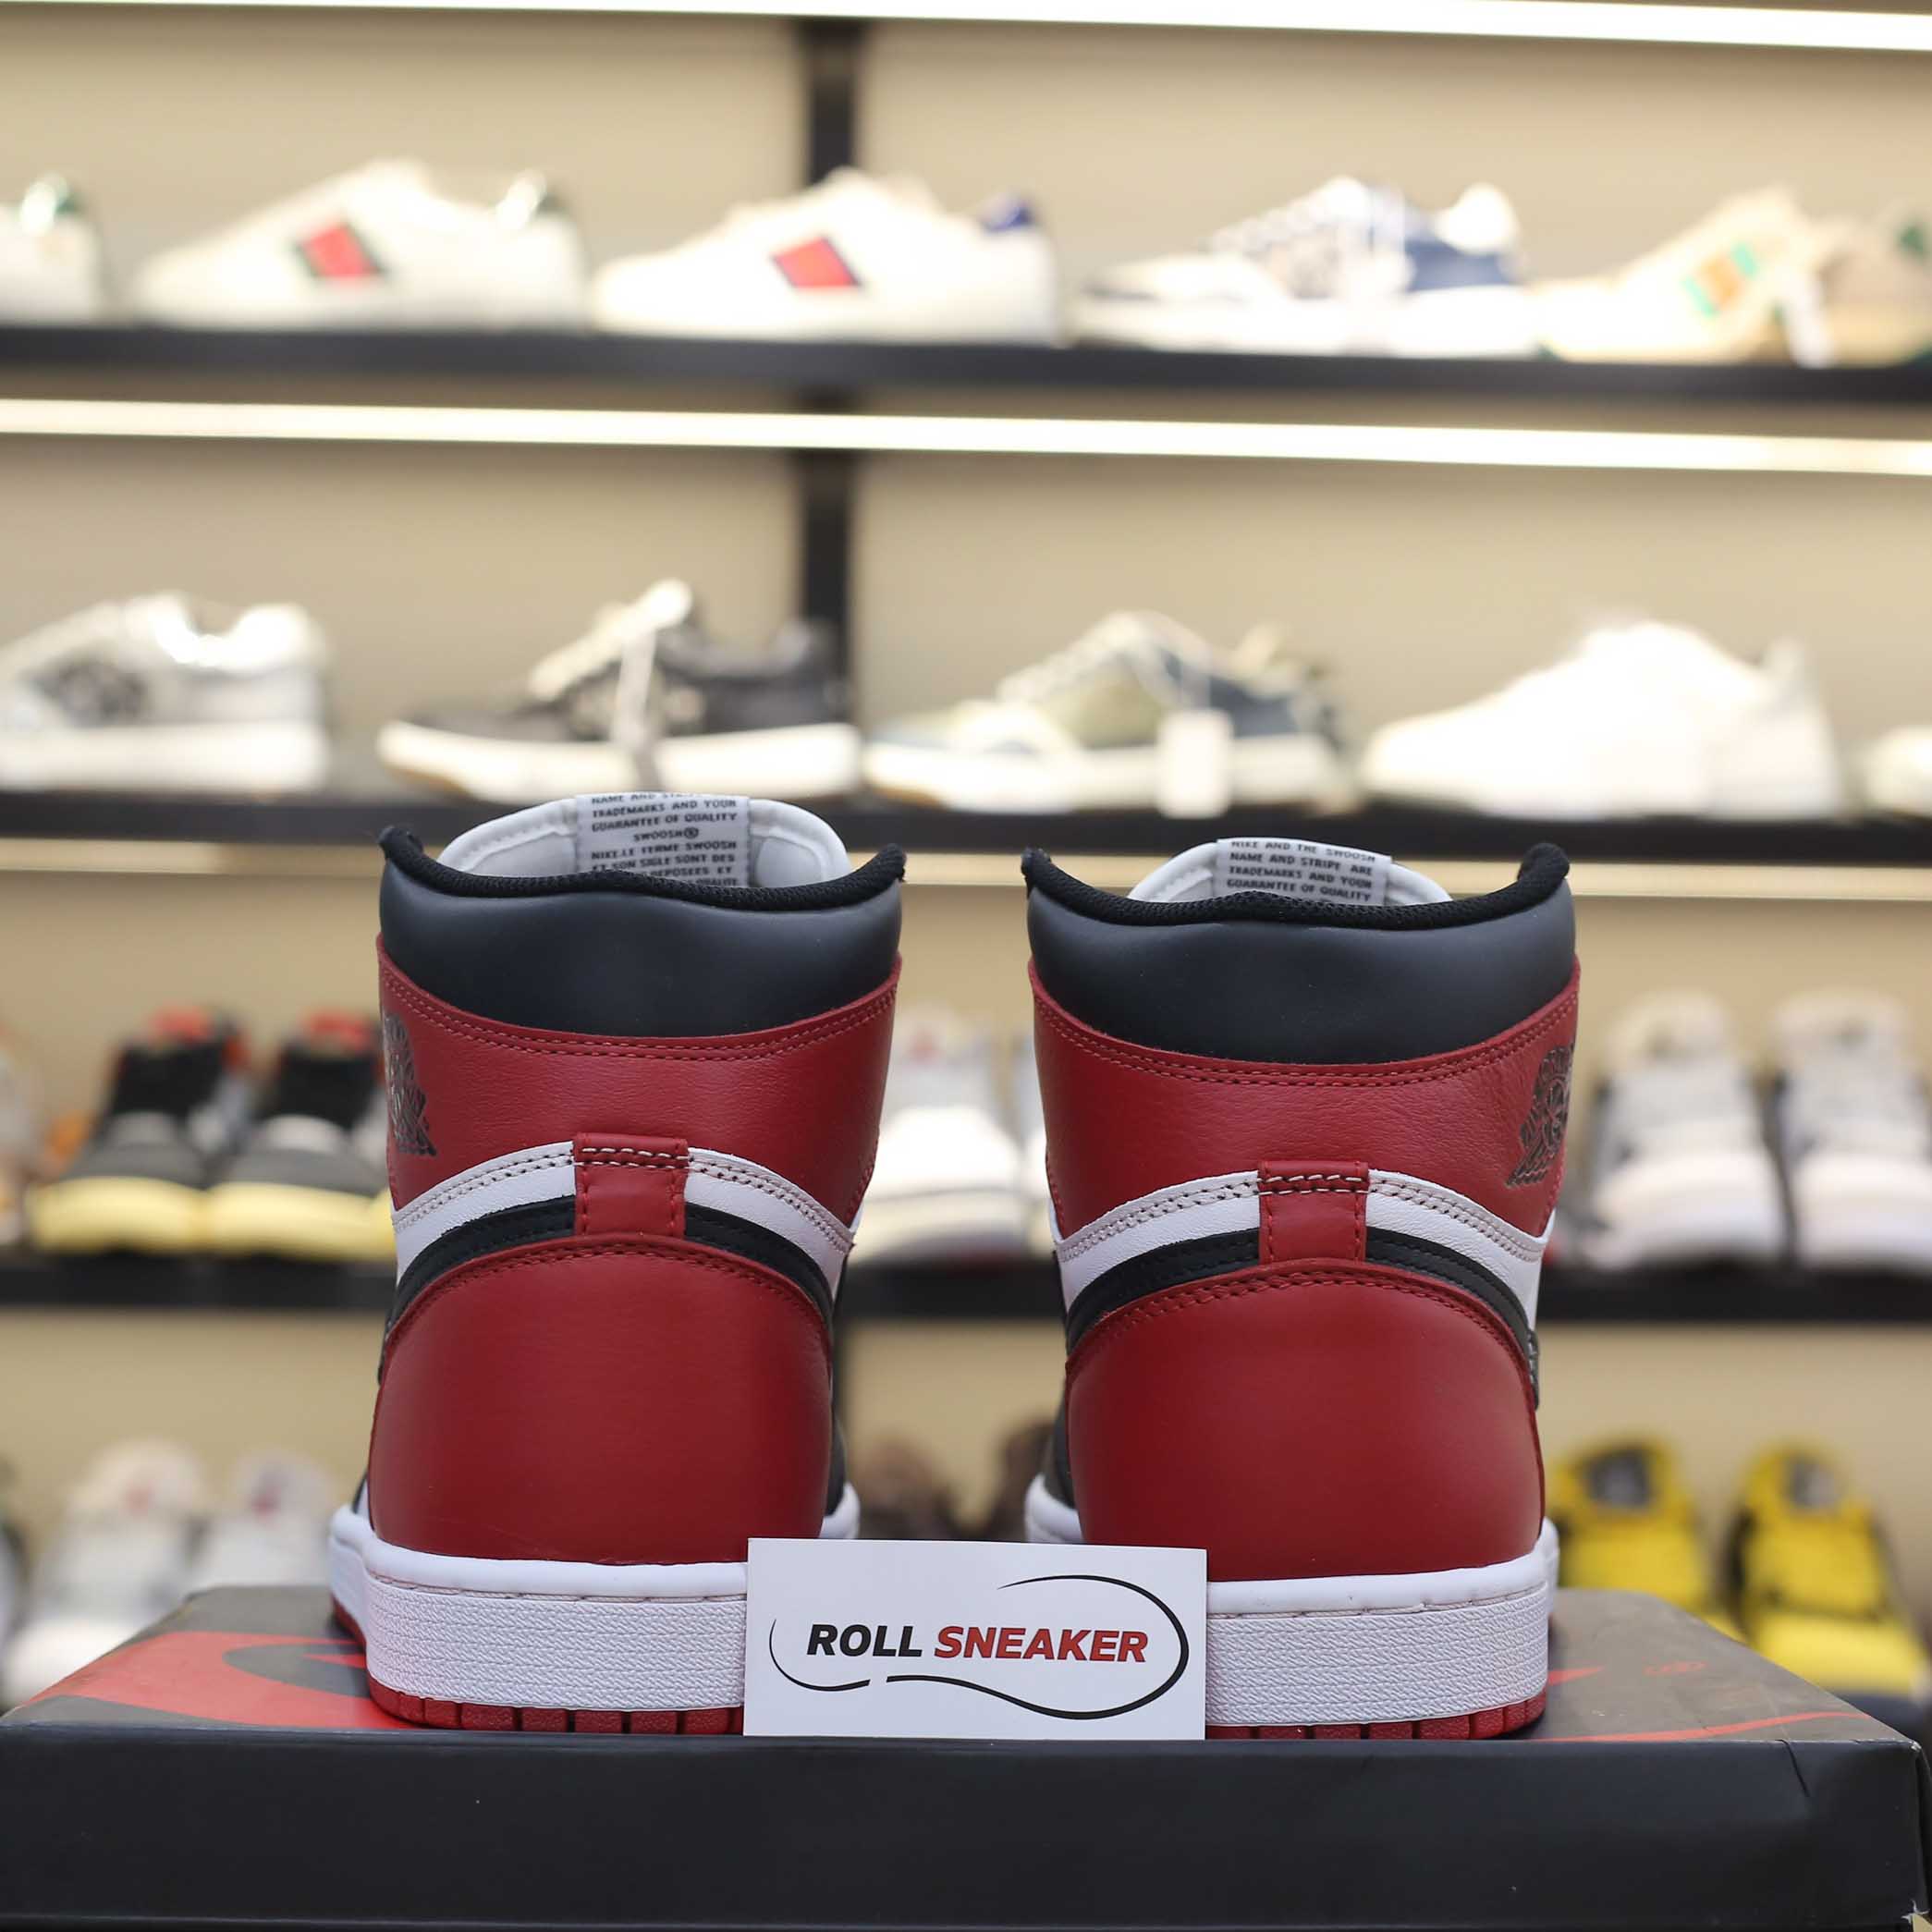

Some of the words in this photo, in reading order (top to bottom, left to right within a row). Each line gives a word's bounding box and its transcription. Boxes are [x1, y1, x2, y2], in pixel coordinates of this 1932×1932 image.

[593, 803, 666, 818] TRADEMARKS
[671, 800, 698, 811] AND
[703, 799, 737, 809] YOUR
[592, 816, 660, 833] GUARANTEE
[665, 813, 679, 824] OF
[684, 812, 738, 823] QUALITY
[685, 840, 737, 850] SWOOSH
[1265, 841, 1291, 850] AND
[1298, 843, 1317, 854] THE
[1325, 848, 1376, 863] SWOOSH
[674, 853, 707, 864] SONT
[711, 853, 735, 862] DES
[1229, 851, 1263, 862] NAME
[1269, 853, 1295, 865] AND
[1301, 857, 1340, 871] STRIPE
[1350, 863, 1373, 876] ARE
[1228, 865, 1302, 879] TRADEMARKS
[1309, 872, 1335, 884] AND
[1339, 875, 1373, 889] YOUR
[1227, 878, 1296, 892] GUARANTEE
[1301, 883, 1315, 893] OF
[1319, 886, 1372, 902] QUALITY
[807, 1622, 923, 1657] ROLL
[934, 1625, 1149, 1664] SNEAKER
